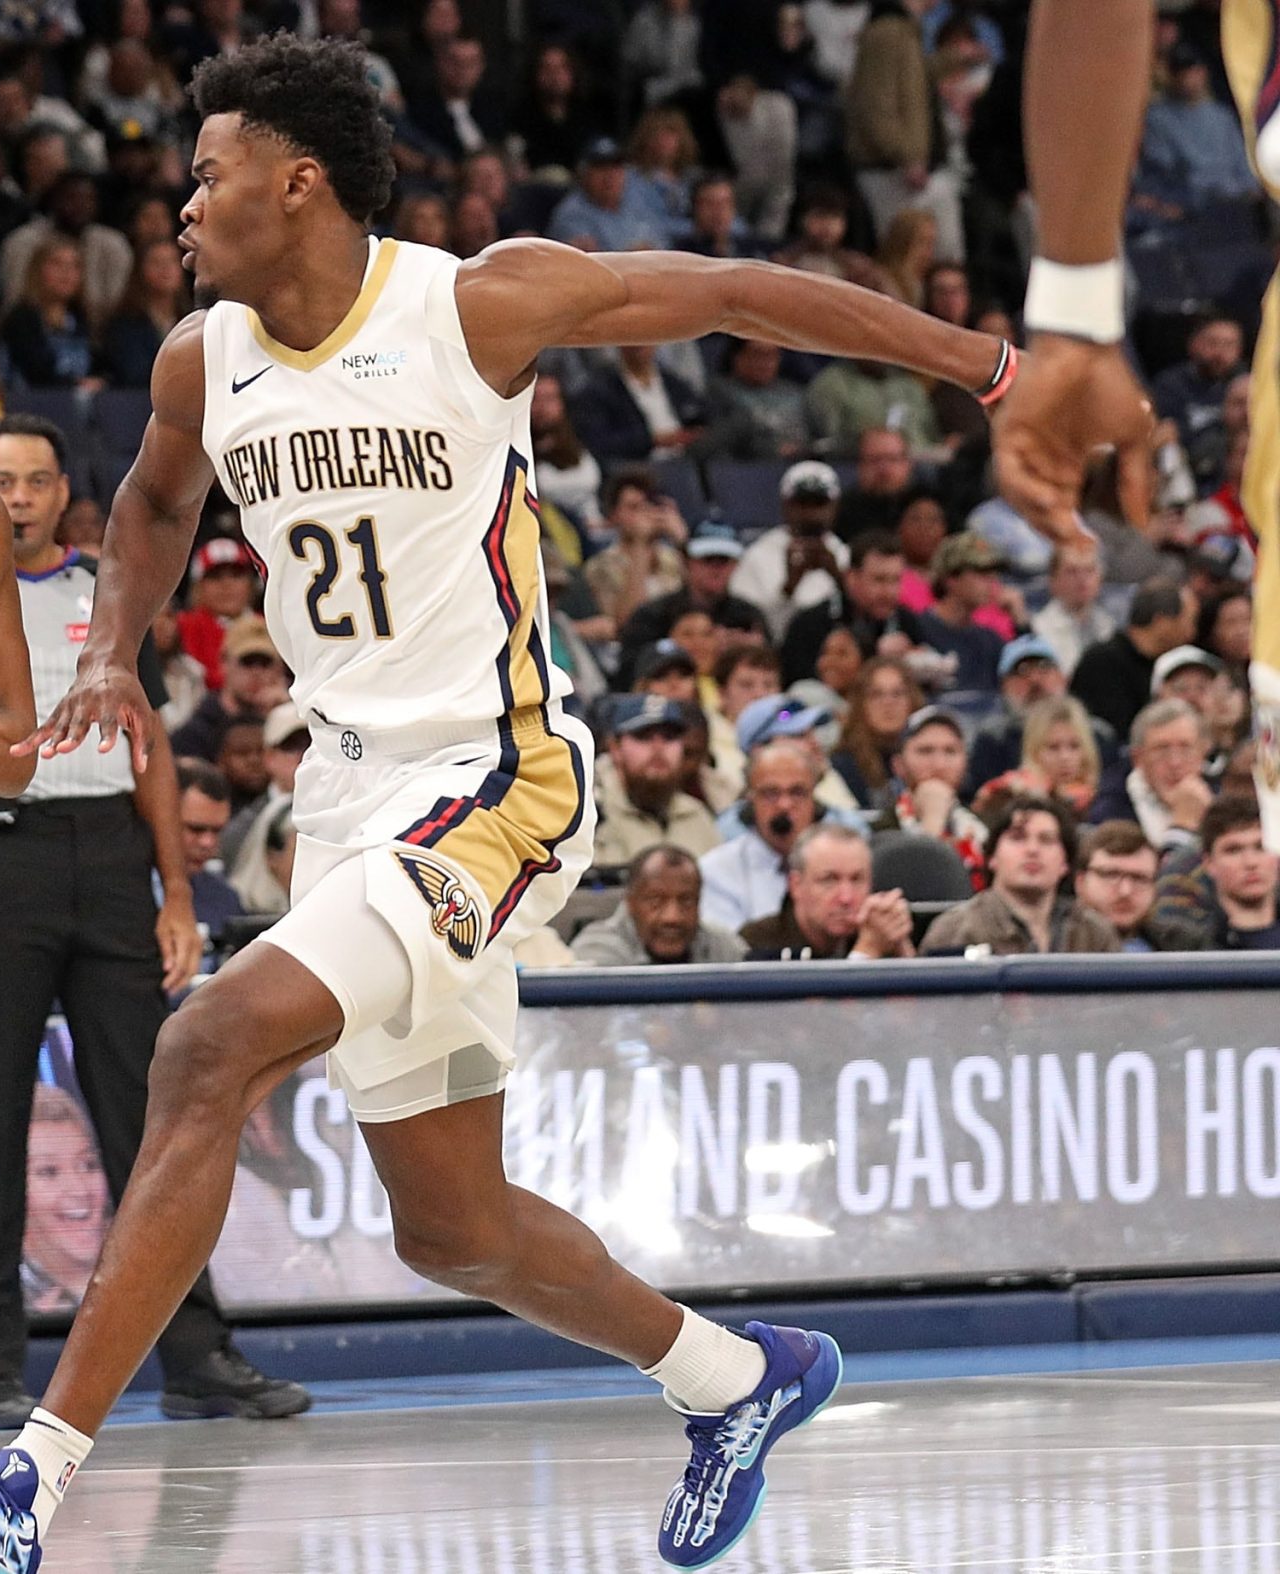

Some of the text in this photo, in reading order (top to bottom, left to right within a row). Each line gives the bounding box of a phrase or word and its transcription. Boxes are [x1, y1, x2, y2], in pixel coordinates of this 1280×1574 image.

[354, 368, 397, 380] GRILLS
[223, 427, 454, 508] NEW ORLEANS
[286, 515, 395, 641] 21
[289, 1047, 1280, 1238] SHLAND CASINO HO
